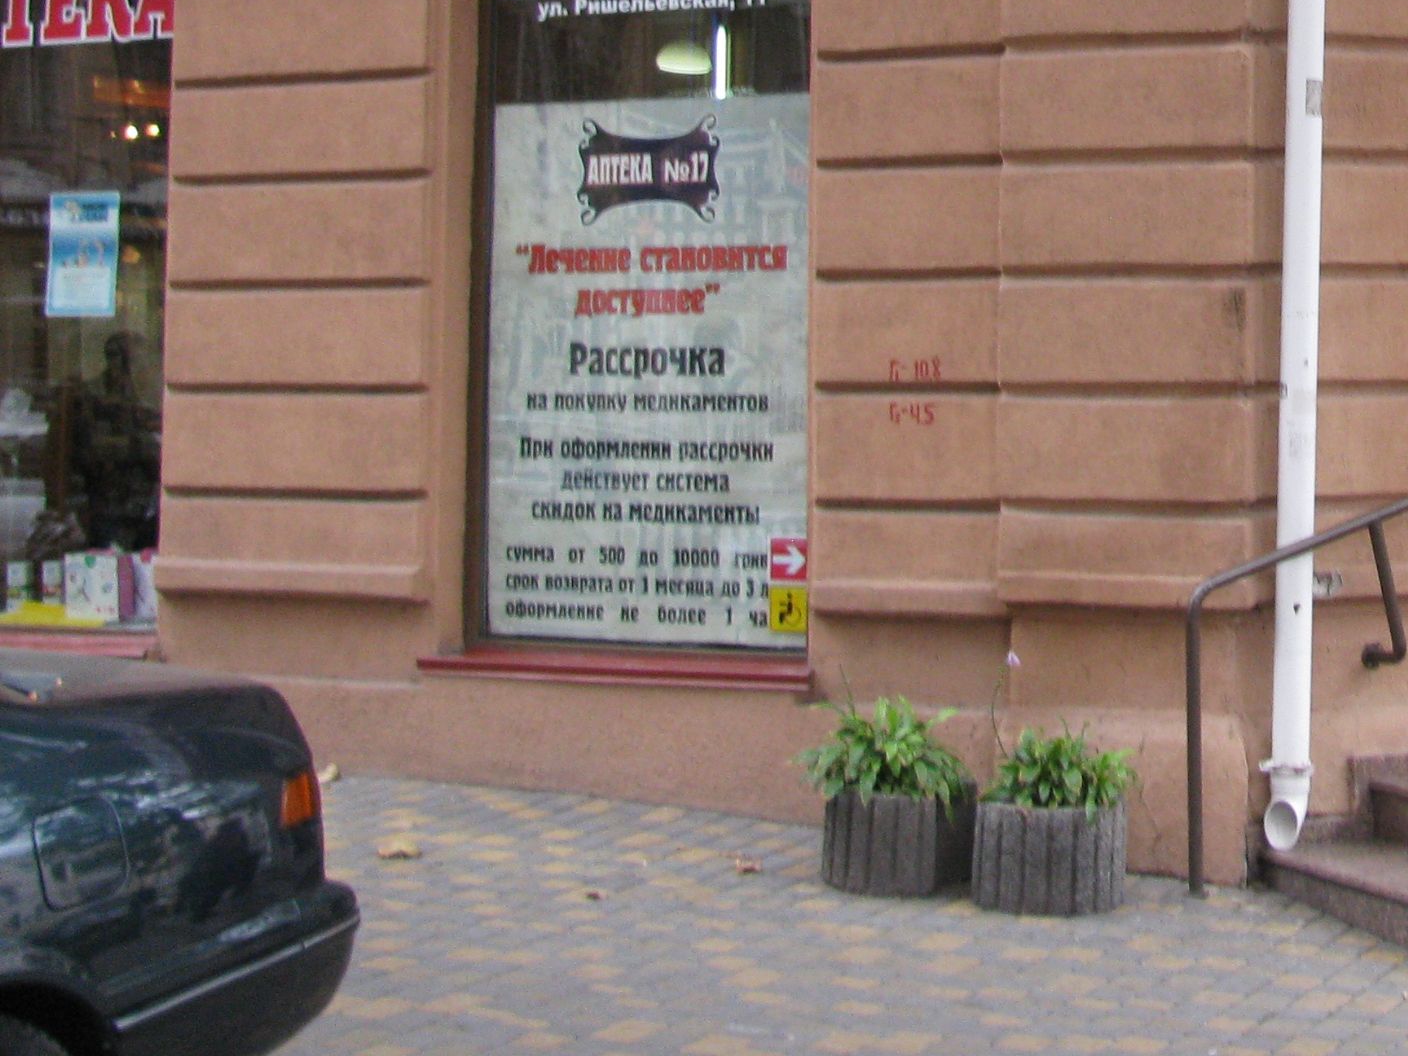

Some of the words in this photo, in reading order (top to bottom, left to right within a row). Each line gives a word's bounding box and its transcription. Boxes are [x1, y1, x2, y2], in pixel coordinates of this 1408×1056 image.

[538, 0, 568, 22] ул.
[587, 152, 653, 185] АПТЕКА
[639, 244, 789, 272] становится
[570, 341, 726, 380] Рассрочка
[527, 393, 548, 412] на
[554, 393, 627, 414] покупку
[633, 393, 769, 414] медикаментов
[520, 436, 552, 460] При
[560, 436, 671, 462] оформлении
[679, 440, 775, 464] рассрочки
[560, 468, 650, 493] действует
[656, 471, 731, 493] система
[531, 499, 596, 524] скидок
[602, 502, 624, 522] на
[629, 501, 761, 526] медикаменты
[505, 546, 555, 564] сумма
[568, 547, 586, 564] от
[599, 546, 627, 565] 500
[639, 549, 660, 567] до
[673, 547, 721, 567] 10000
[505, 573, 540, 592] срок
[546, 575, 613, 593] возврата
[618, 577, 635, 593] от
[642, 575, 649, 593] 1
[655, 578, 715, 596] месяца
[721, 580, 741, 599] до
[746, 579, 755, 597] 3
[505, 599, 605, 621] оформление
[620, 604, 640, 622] не
[657, 603, 707, 625] более
[725, 604, 733, 626] 1
